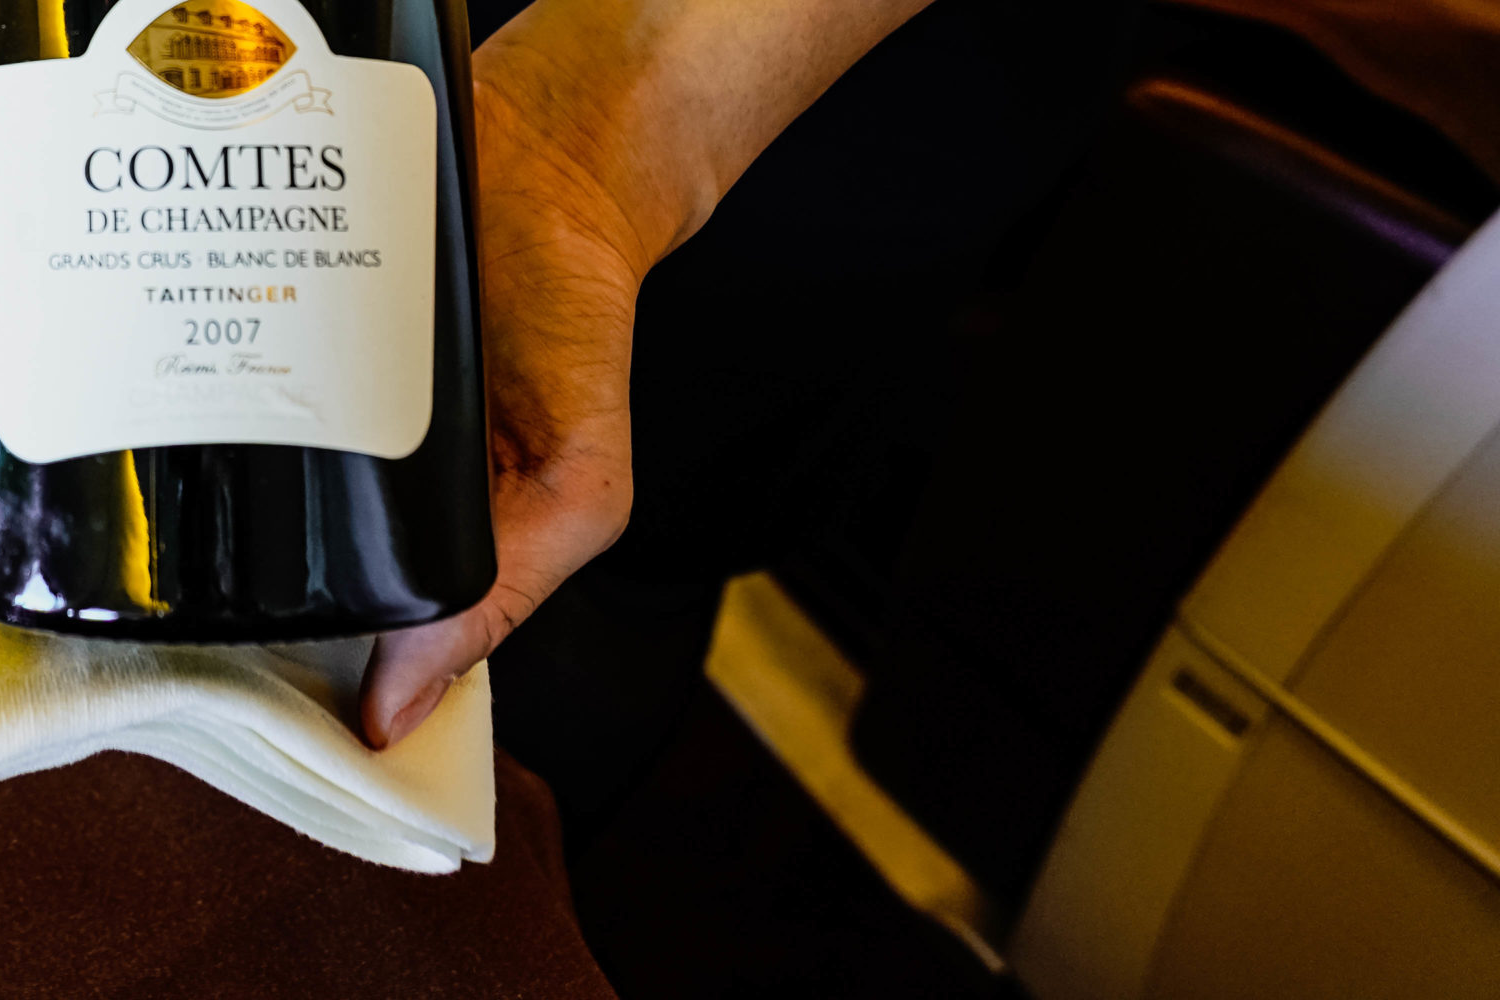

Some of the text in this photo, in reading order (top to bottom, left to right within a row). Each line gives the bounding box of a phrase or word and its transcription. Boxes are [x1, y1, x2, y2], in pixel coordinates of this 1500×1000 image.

[83, 143, 348, 194] COMTES
[85, 205, 350, 235] DE CHAMPAGNE
[48, 249, 383, 270] GRANDS CRUS BLANC DE BLANCS
[143, 286, 298, 304] TAITTINGER
[183, 317, 262, 346] 2007
